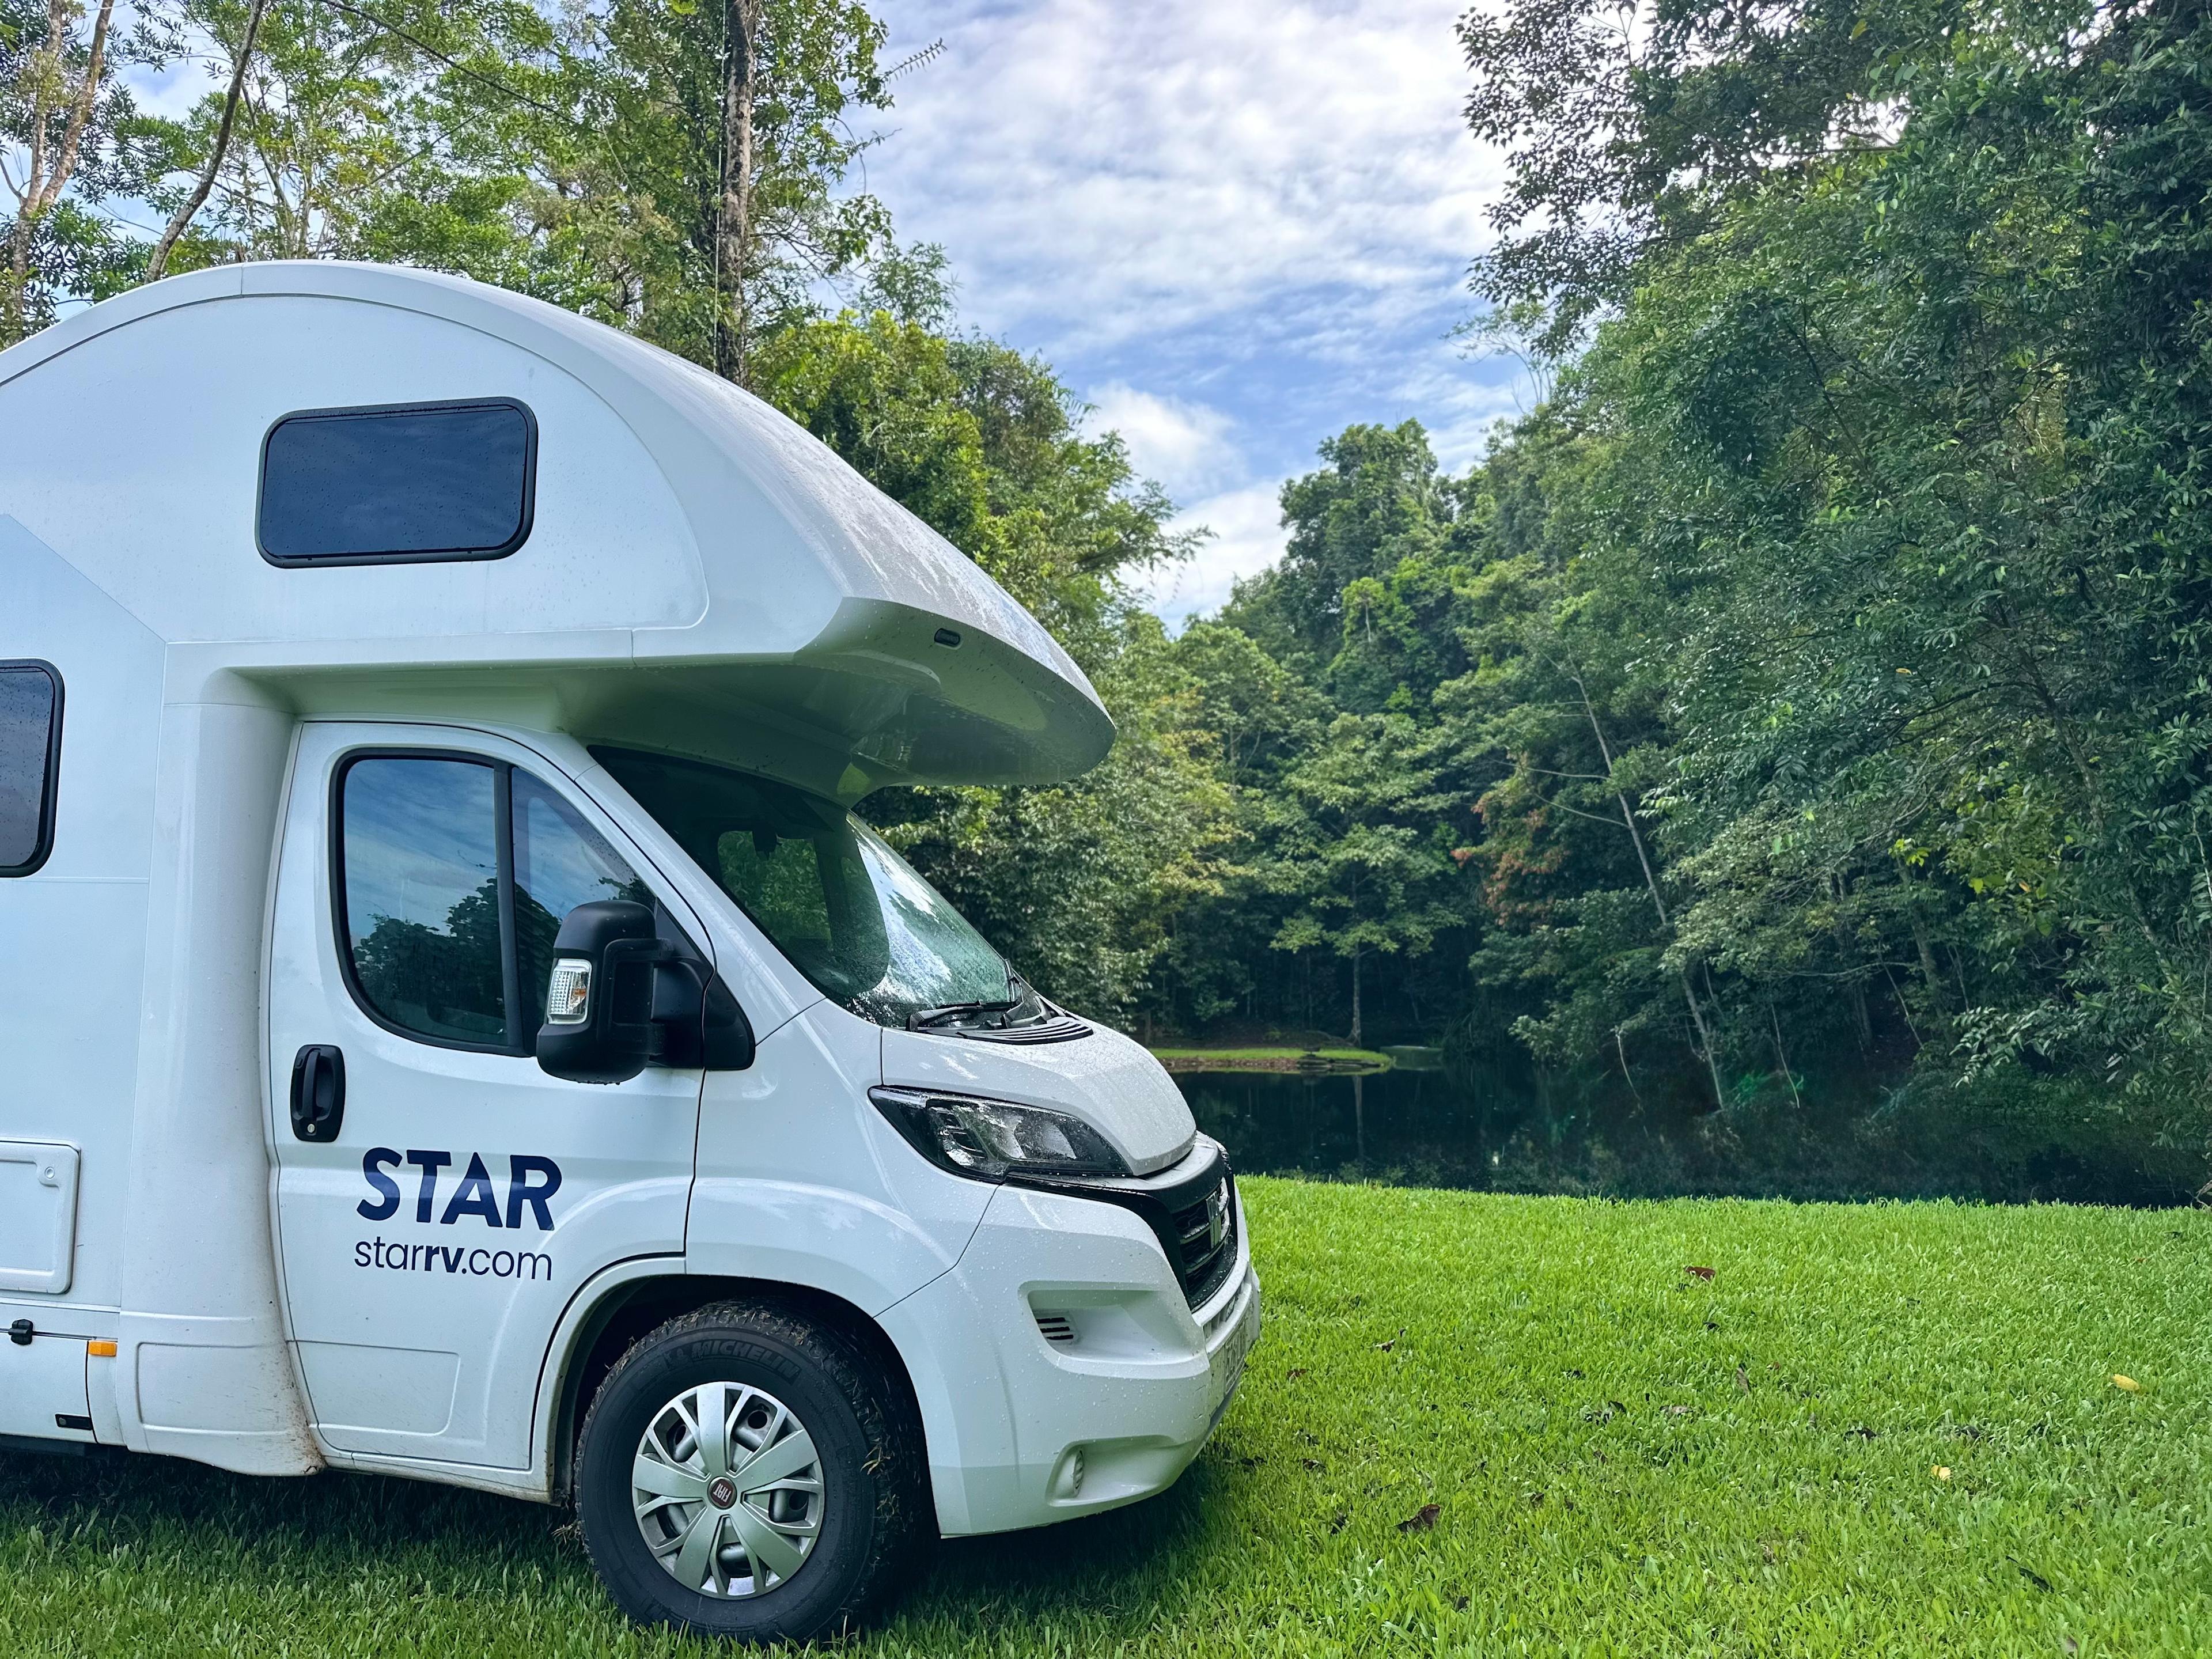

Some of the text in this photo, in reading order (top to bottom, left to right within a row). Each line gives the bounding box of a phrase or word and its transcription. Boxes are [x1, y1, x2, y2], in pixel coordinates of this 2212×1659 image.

[357, 1147, 562, 1230] STAR
[354, 1236, 552, 1280] starrv.com
[692, 1340, 800, 1377] MICHELIN
[713, 1483, 732, 1502] FIAT
